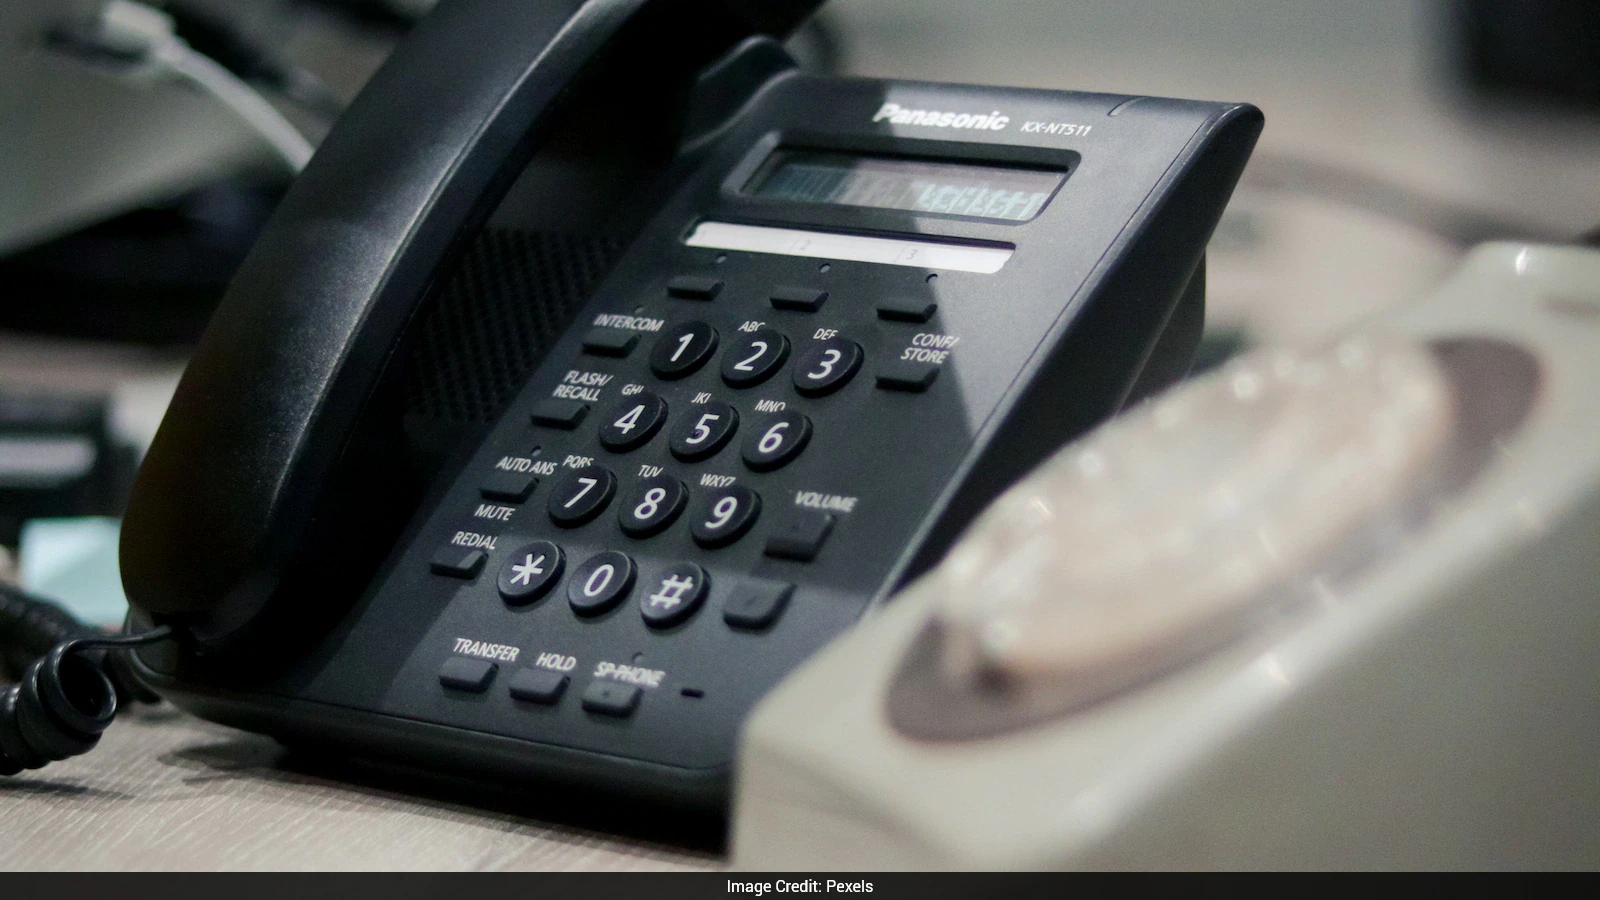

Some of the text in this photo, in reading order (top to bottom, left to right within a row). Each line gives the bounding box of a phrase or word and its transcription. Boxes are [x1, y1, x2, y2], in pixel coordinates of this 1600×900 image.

[872, 102, 1010, 131] Panasonic
[1020, 121, 1092, 137] KX-NT511
[905, 248, 918, 260] 3
[593, 313, 665, 332] INTERCOM
[812, 328, 838, 341] DEF
[670, 333, 694, 362] 1
[734, 341, 768, 371] 2
[900, 347, 949, 364] STORE
[807, 349, 841, 379] 3
[563, 370, 614, 387] FLASH/
[621, 383, 644, 396] GHI
[552, 385, 602, 402] RECALL
[613, 404, 646, 434] 4
[685, 413, 720, 444] 5
[758, 421, 790, 453] 6
[495, 456, 558, 475] AUTO ANS
[637, 464, 664, 478] TUV
[564, 477, 598, 508] 7
[633, 487, 666, 520] 8
[794, 490, 858, 513] VOLUME
[474, 504, 516, 521] MUTE
[704, 496, 738, 529] 9
[451, 531, 499, 550] REDIAL
[583, 563, 615, 597] 0
[453, 637, 520, 662] TRANSFER
[536, 652, 577, 672] HOLD
[593, 661, 666, 688] SP-PHONE
